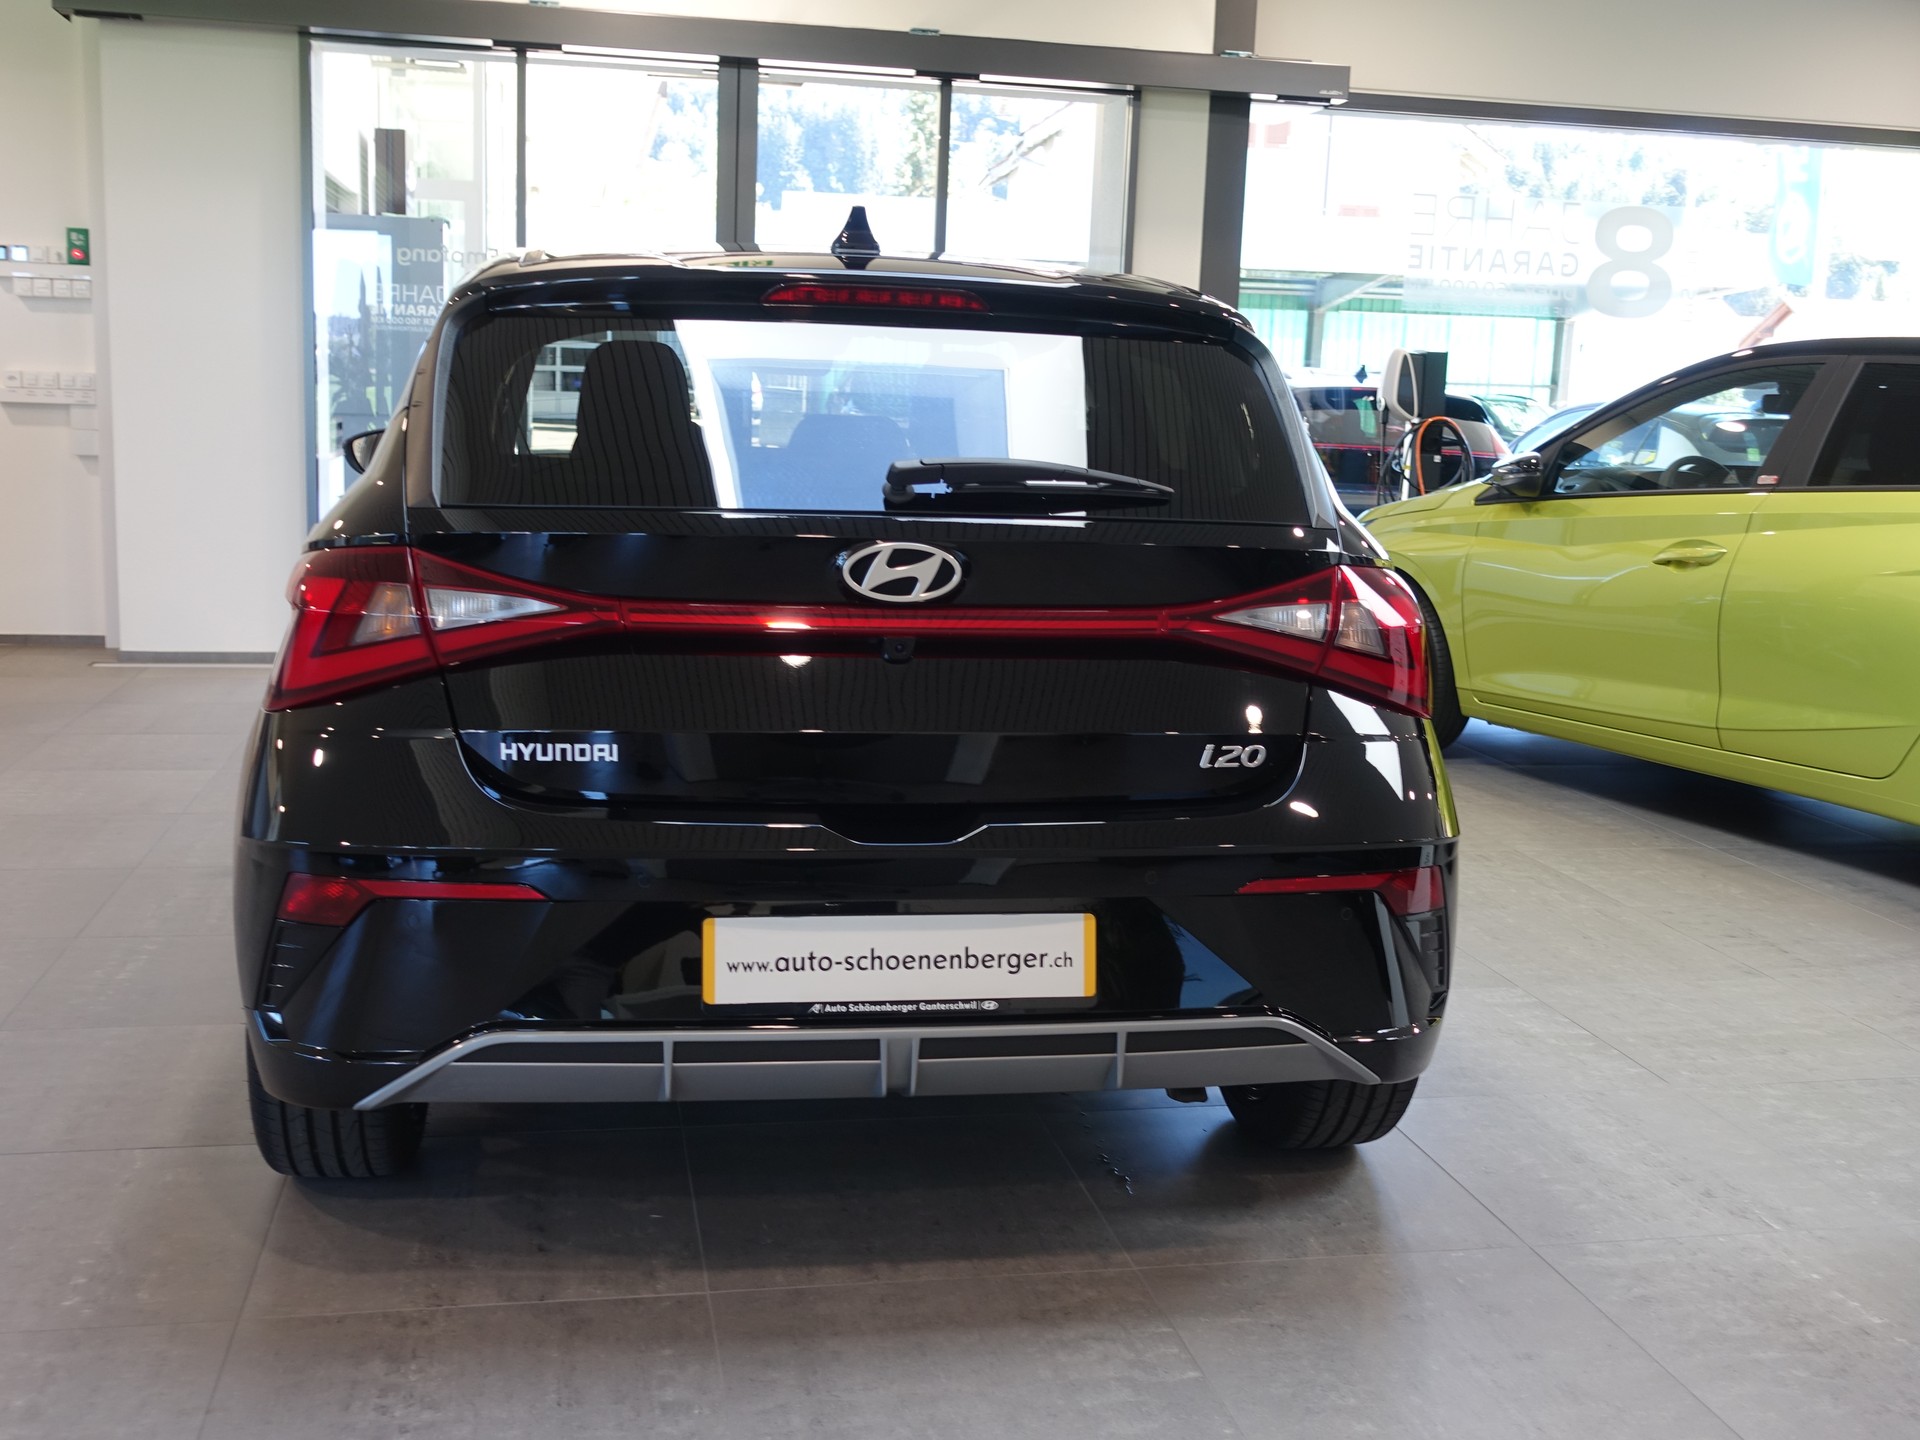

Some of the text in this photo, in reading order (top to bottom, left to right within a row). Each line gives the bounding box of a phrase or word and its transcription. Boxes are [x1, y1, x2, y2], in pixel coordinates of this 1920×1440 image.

[500, 742, 619, 762] HYUNDAI
[1199, 743, 1267, 769] i20
[725, 946, 1074, 974] www.auto-schoenenberger.ch
[824, 1003, 848, 1013] Auto
[849, 1002, 918, 1013] Schönenberger
